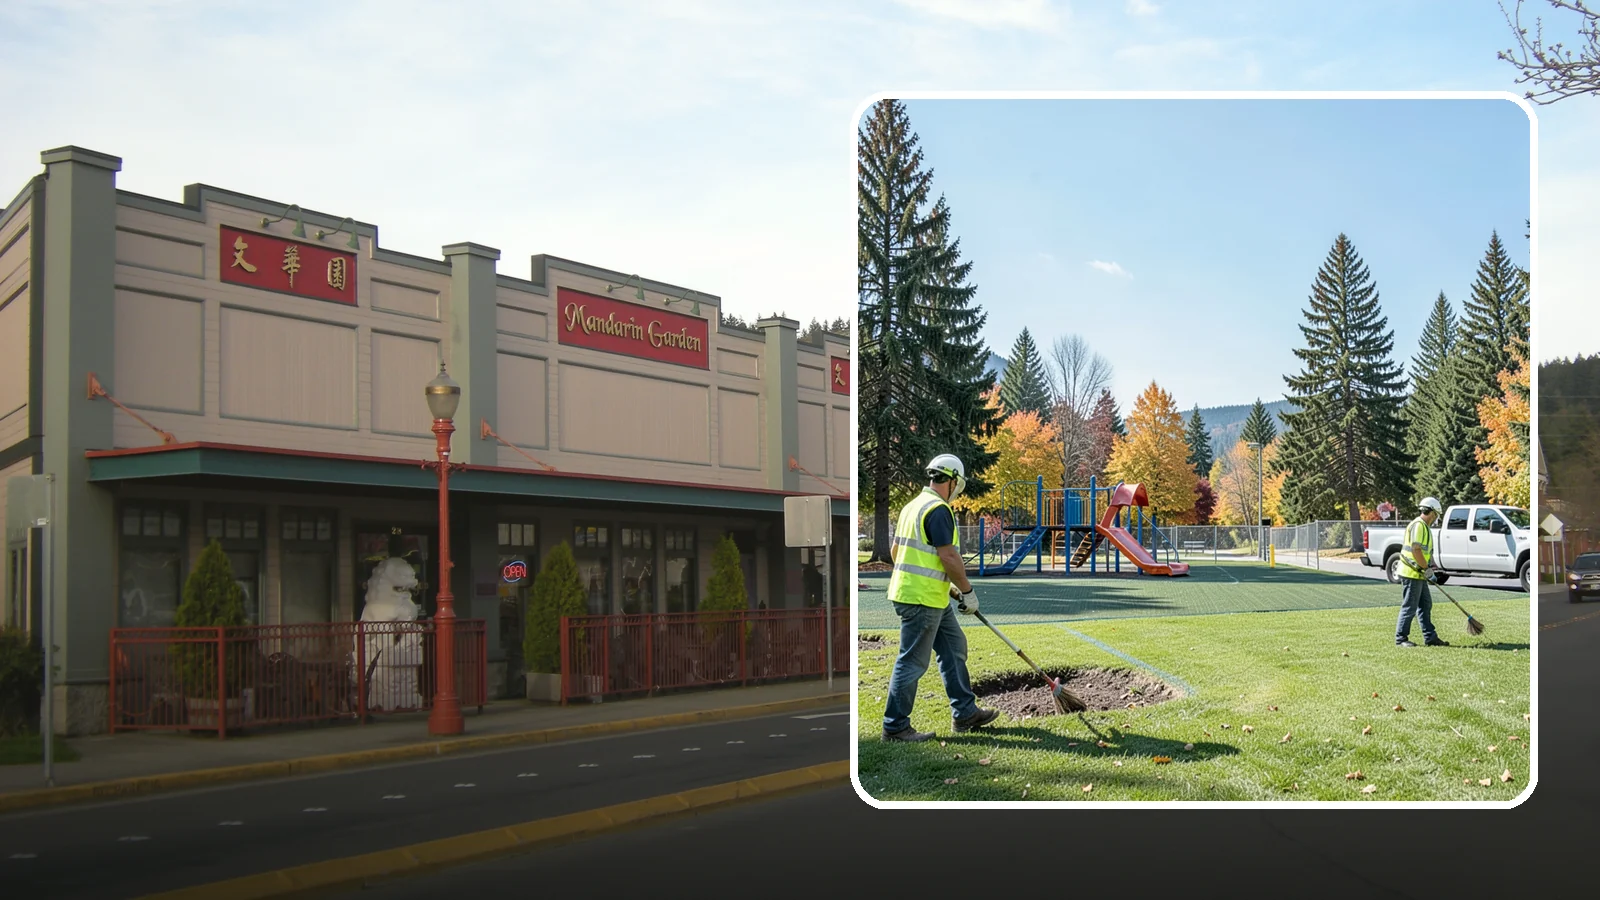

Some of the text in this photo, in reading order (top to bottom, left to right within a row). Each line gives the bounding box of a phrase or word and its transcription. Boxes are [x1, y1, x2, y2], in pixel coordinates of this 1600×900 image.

[230, 236, 346, 291] 文華園
[564, 302, 702, 352] Mandarin Garden
[503, 565, 527, 578] OPEN
